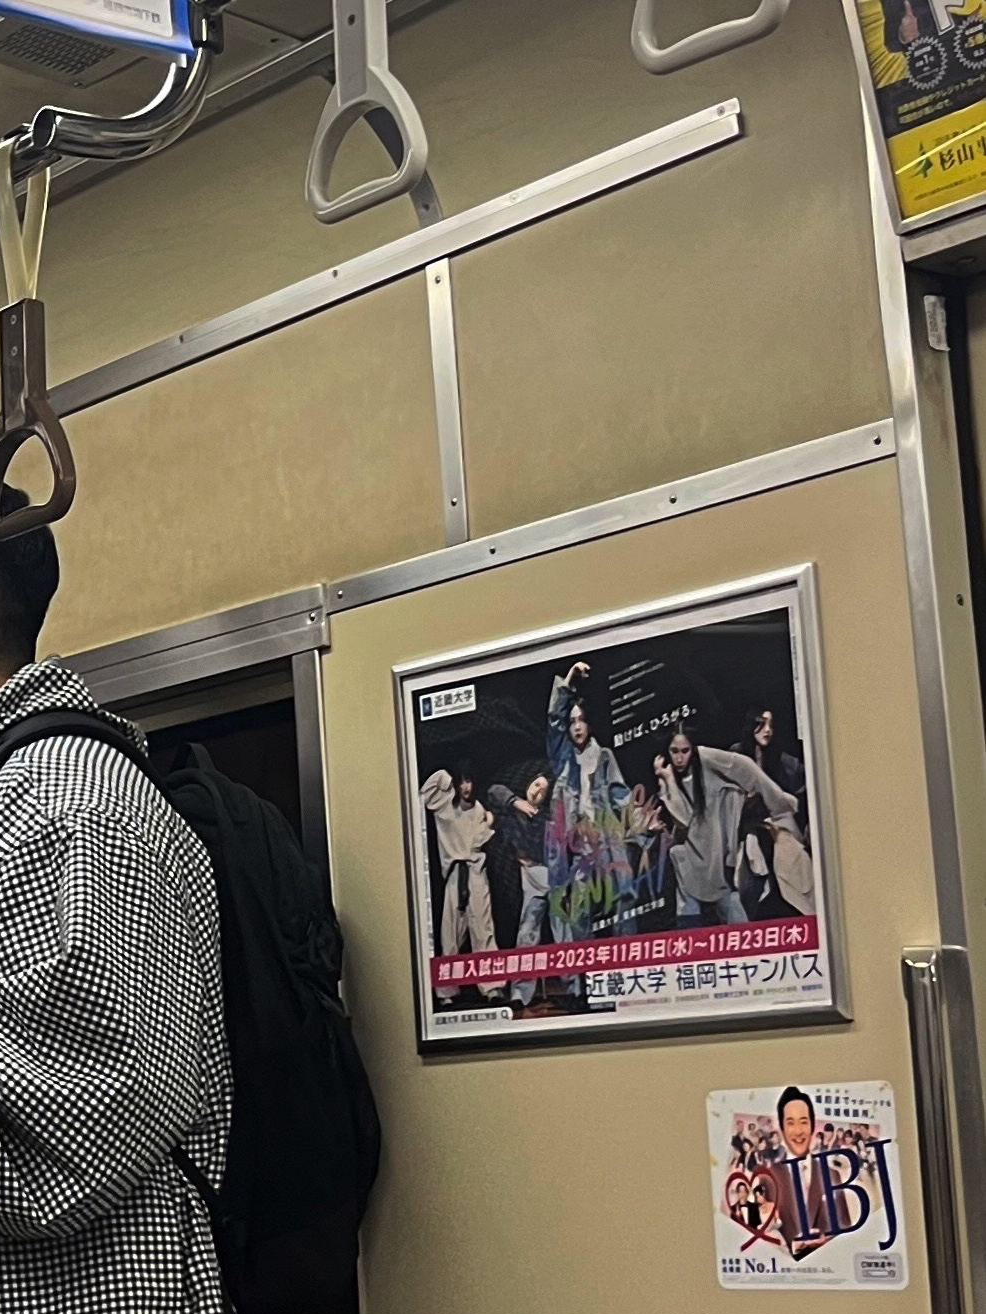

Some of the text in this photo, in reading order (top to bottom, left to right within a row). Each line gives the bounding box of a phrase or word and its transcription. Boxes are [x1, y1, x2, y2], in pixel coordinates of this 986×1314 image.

[586, 953, 823, 998] 近畿大学 福岡キャンパス
[781, 1138, 898, 1251] IBJ
[745, 1257, 778, 1274] No.1
